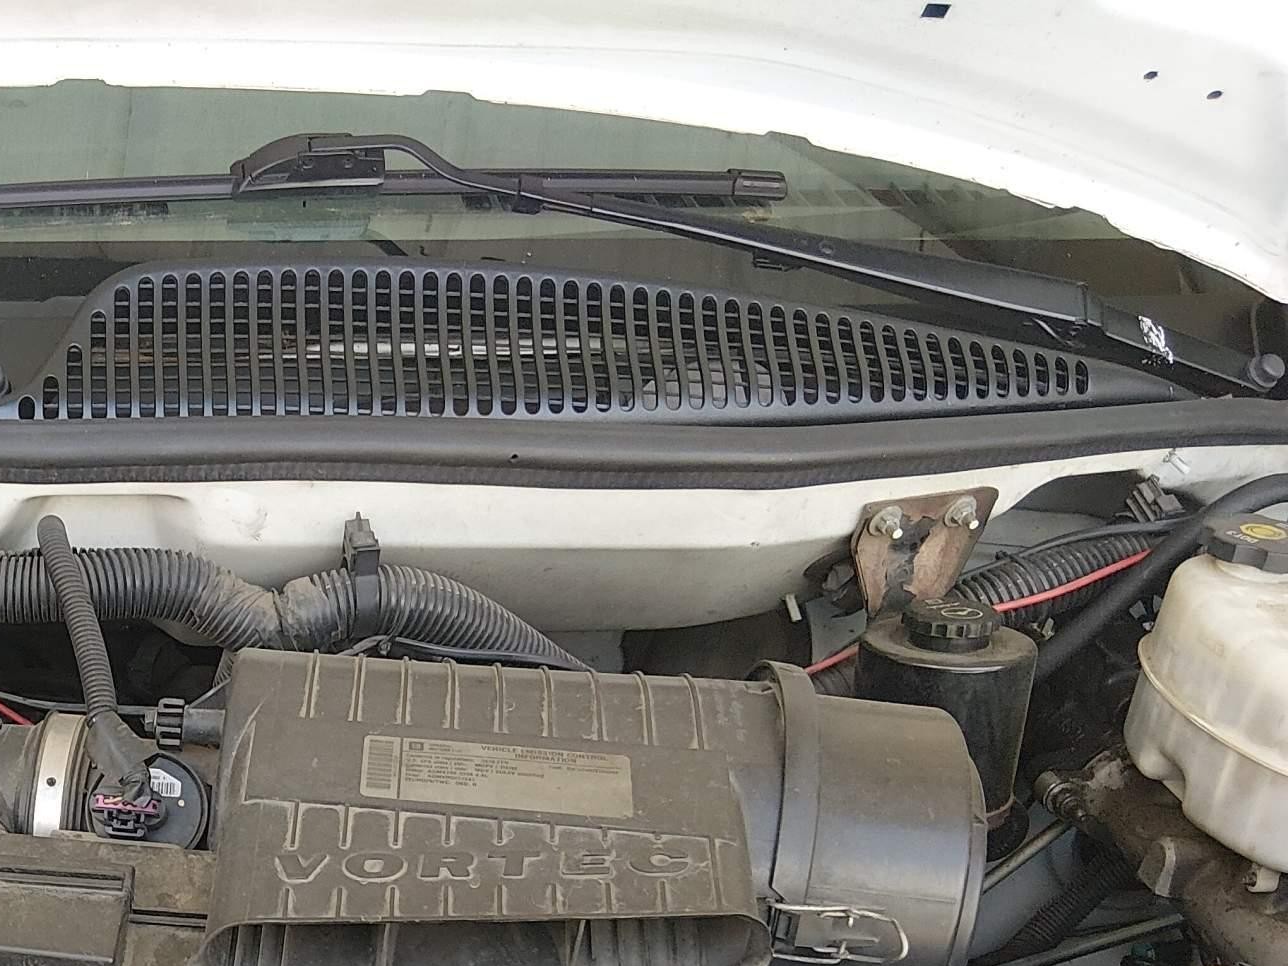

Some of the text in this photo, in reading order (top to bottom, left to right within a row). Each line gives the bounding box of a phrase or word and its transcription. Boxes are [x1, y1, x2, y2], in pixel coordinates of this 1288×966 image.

[480, 745, 516, 753] VEHICLE
[566, 752, 609, 762] CONTROL
[275, 847, 690, 882] VORTEC
